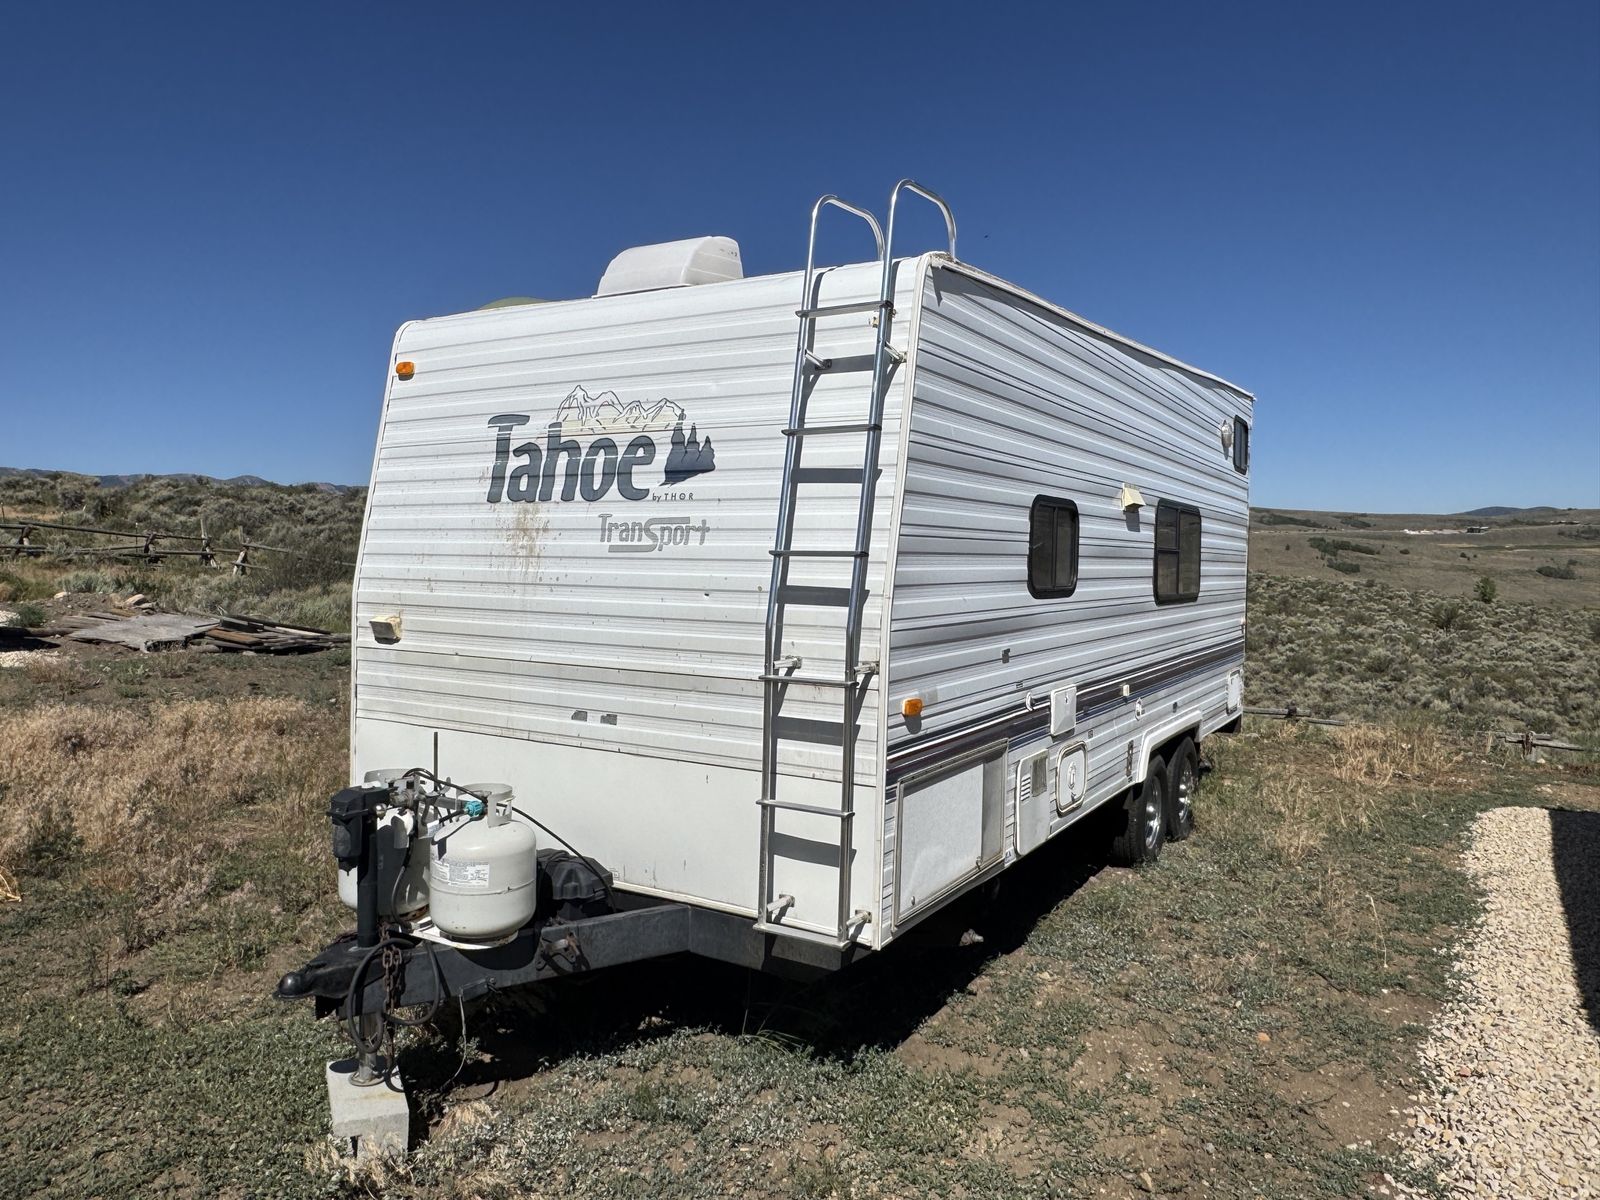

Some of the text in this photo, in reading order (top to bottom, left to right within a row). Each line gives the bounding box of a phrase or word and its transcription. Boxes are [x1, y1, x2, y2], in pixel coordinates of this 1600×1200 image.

[487, 414, 656, 503] Tahoe
[652, 492, 694, 503] by THOR
